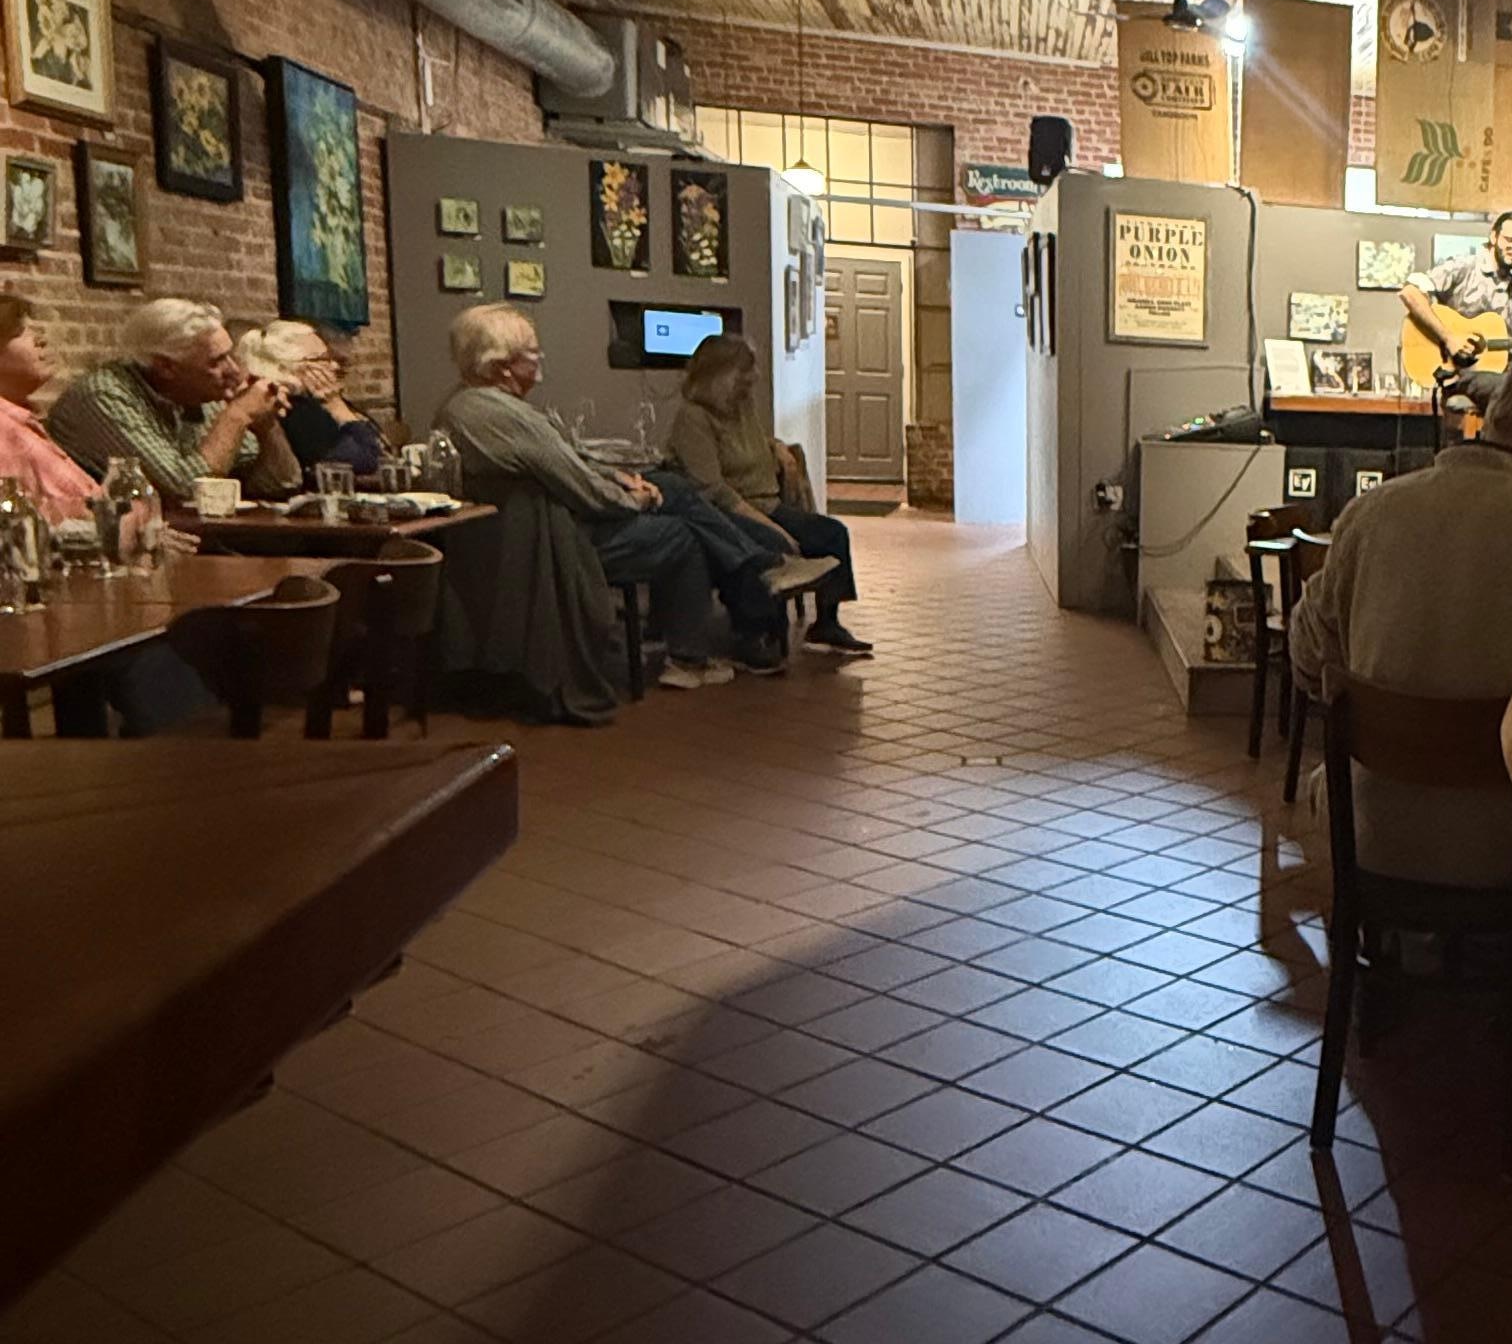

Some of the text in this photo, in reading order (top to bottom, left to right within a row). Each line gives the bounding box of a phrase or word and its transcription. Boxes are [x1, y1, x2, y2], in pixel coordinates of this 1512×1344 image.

[967, 169, 1048, 195] Restroom
[1119, 224, 1204, 247] PURPLE
[1129, 244, 1190, 264] ONION
